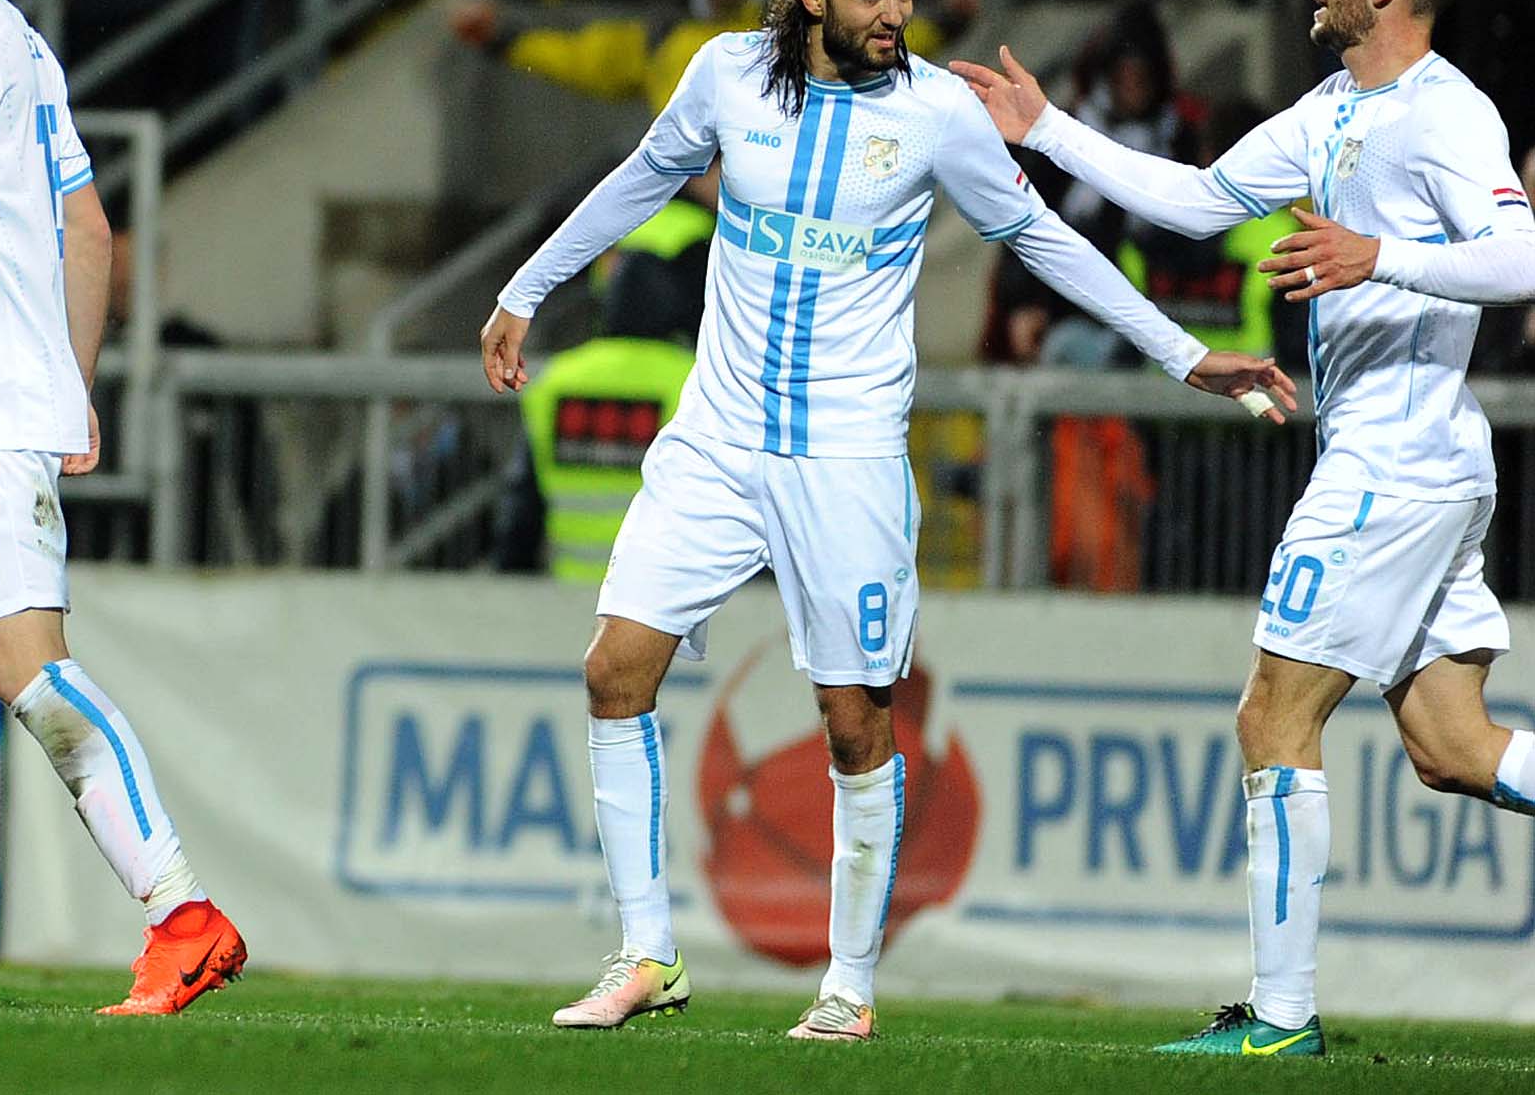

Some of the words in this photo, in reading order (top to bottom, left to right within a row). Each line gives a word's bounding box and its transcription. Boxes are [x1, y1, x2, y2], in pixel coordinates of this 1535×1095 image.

[743, 130, 782, 149] JAKO
[802, 227, 867, 257] SAVA
[858, 582, 888, 653] 8
[1261, 546, 1324, 624] 20
[376, 711, 672, 854] MA
